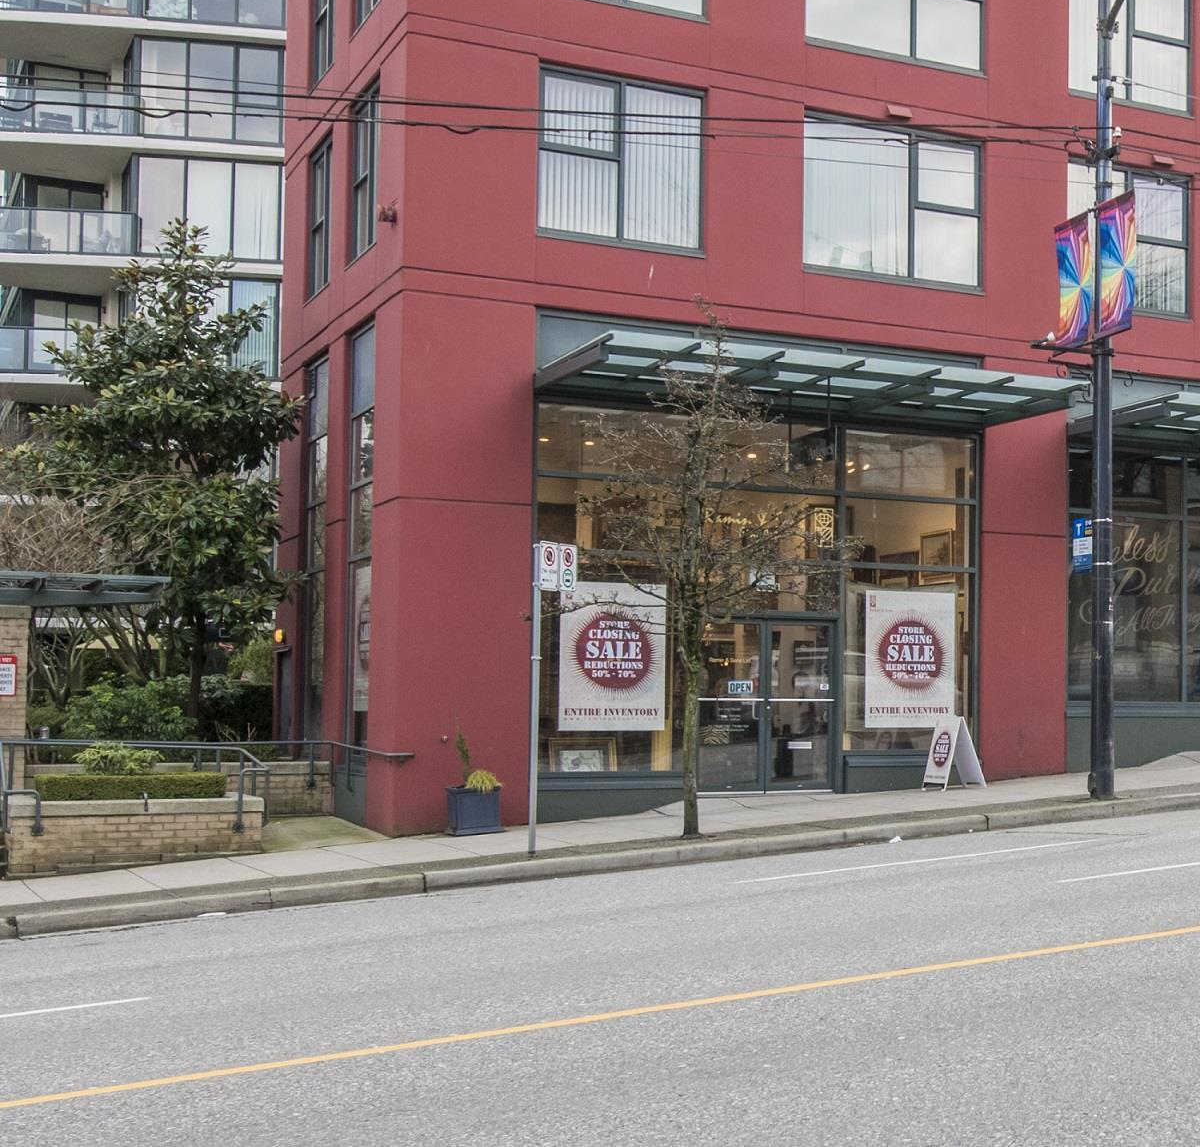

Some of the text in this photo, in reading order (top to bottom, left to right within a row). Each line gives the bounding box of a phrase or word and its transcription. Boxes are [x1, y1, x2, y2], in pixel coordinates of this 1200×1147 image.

[599, 620, 630, 629] STORE
[588, 629, 640, 640] CLOSING
[898, 626, 925, 634] STORE
[889, 634, 933, 644] CLOSING
[585, 640, 642, 659] SALE
[887, 645, 935, 662] SALE
[583, 661, 644, 669] REDUCTIONS
[885, 663, 936, 671] REDUCTIONS
[591, 670, 611, 678] 50%
[617, 670, 636, 678] 70%
[730, 683, 752, 692] OPEN
[564, 708, 660, 717] ENTIRE INVENTORY
